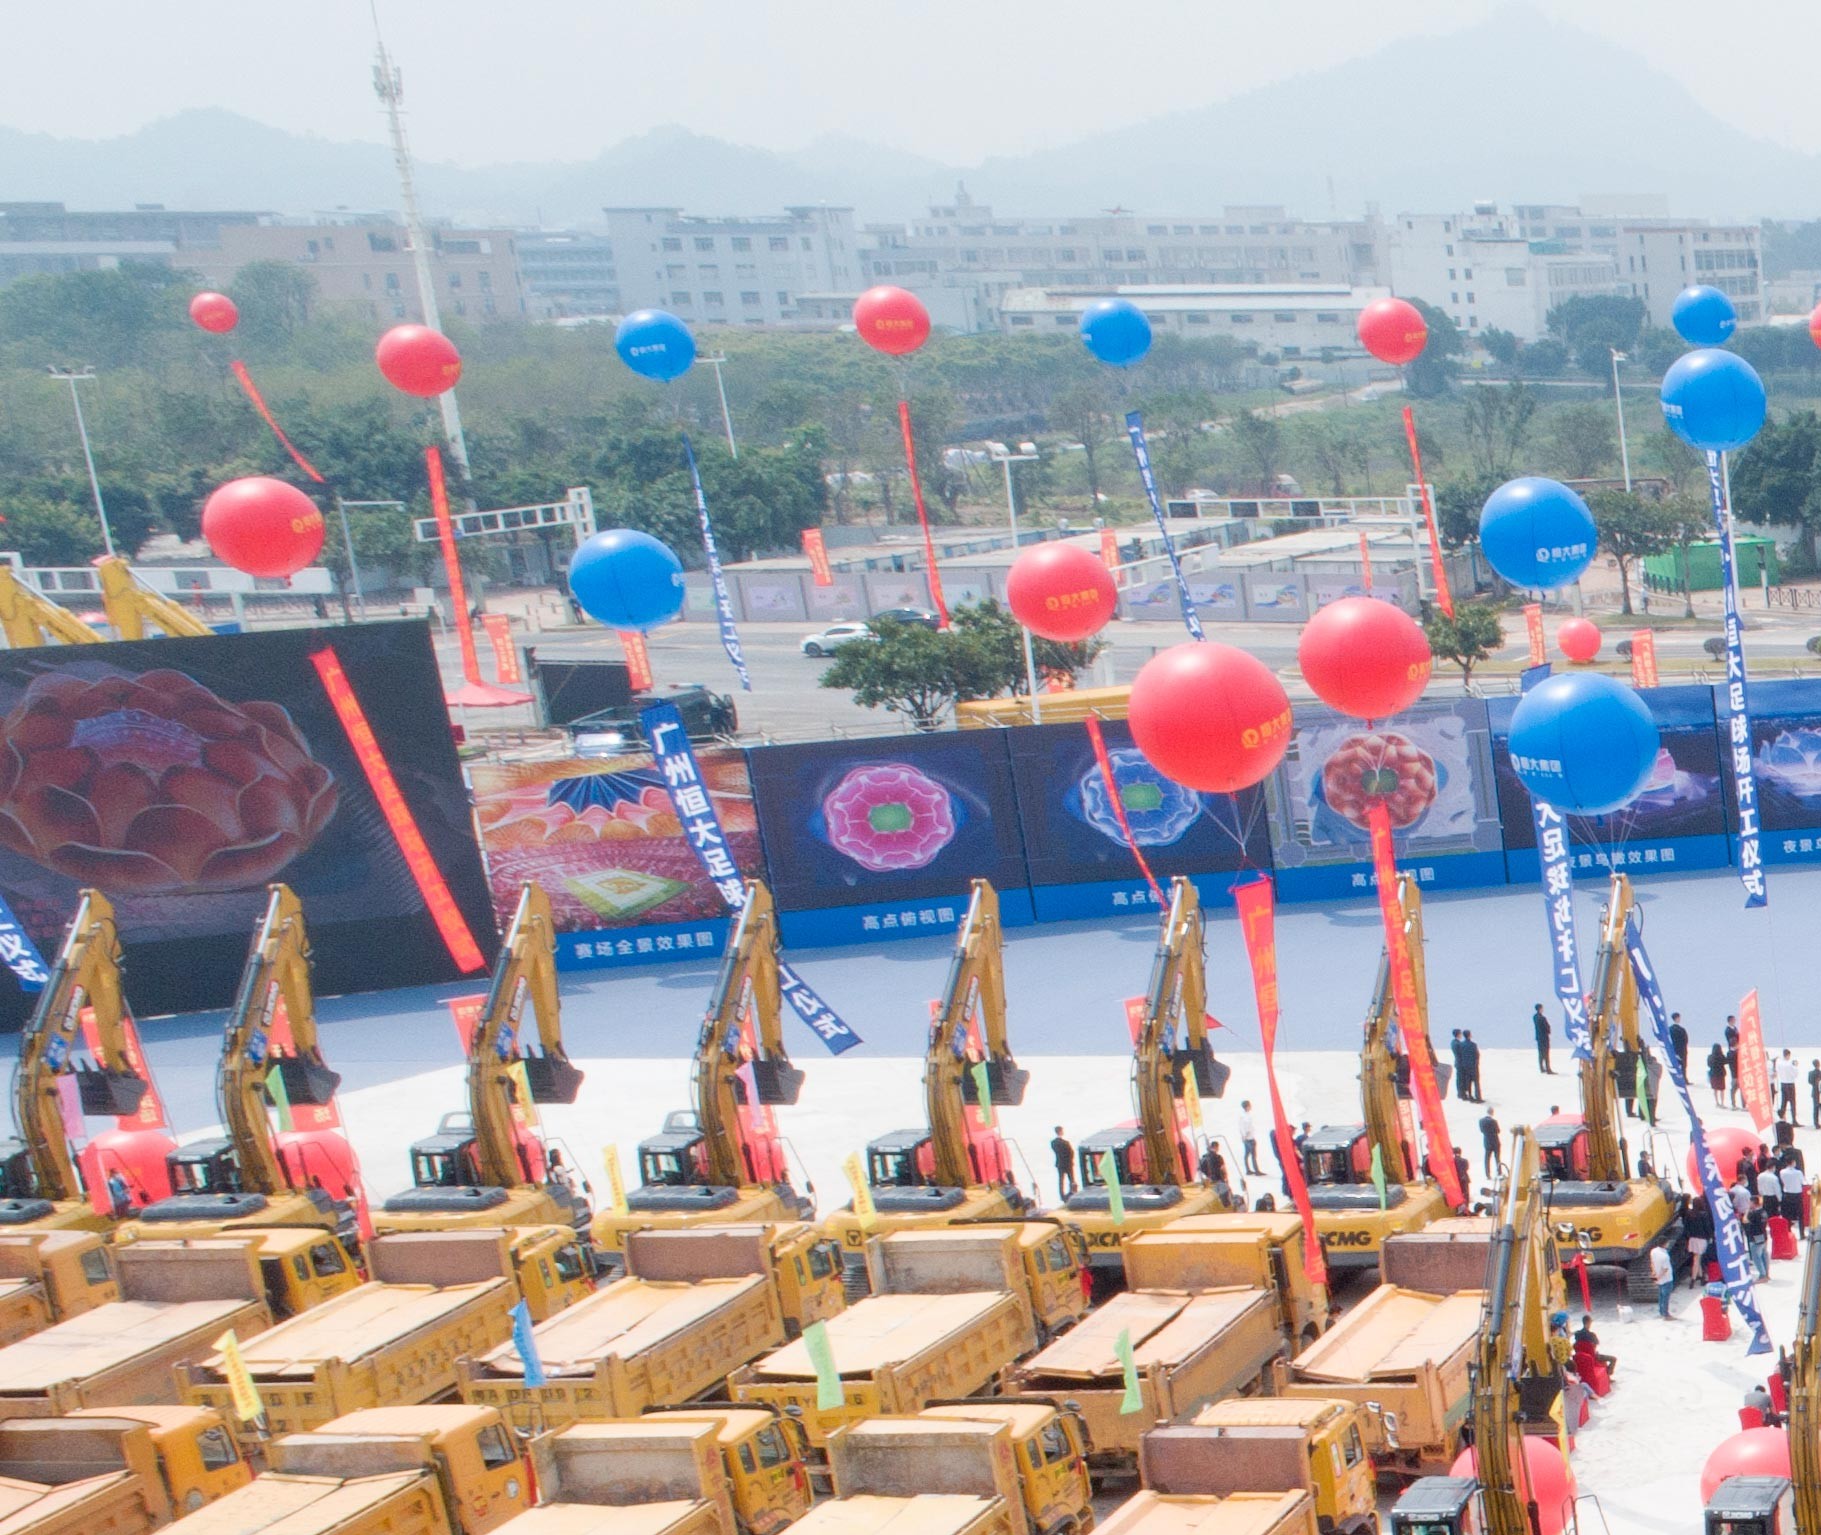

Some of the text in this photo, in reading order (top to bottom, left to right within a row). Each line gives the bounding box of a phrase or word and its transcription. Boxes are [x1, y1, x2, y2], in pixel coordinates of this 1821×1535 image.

[862, 907, 955, 931] 高点俯视图
[575, 931, 714, 960] 赛场全景效果图
